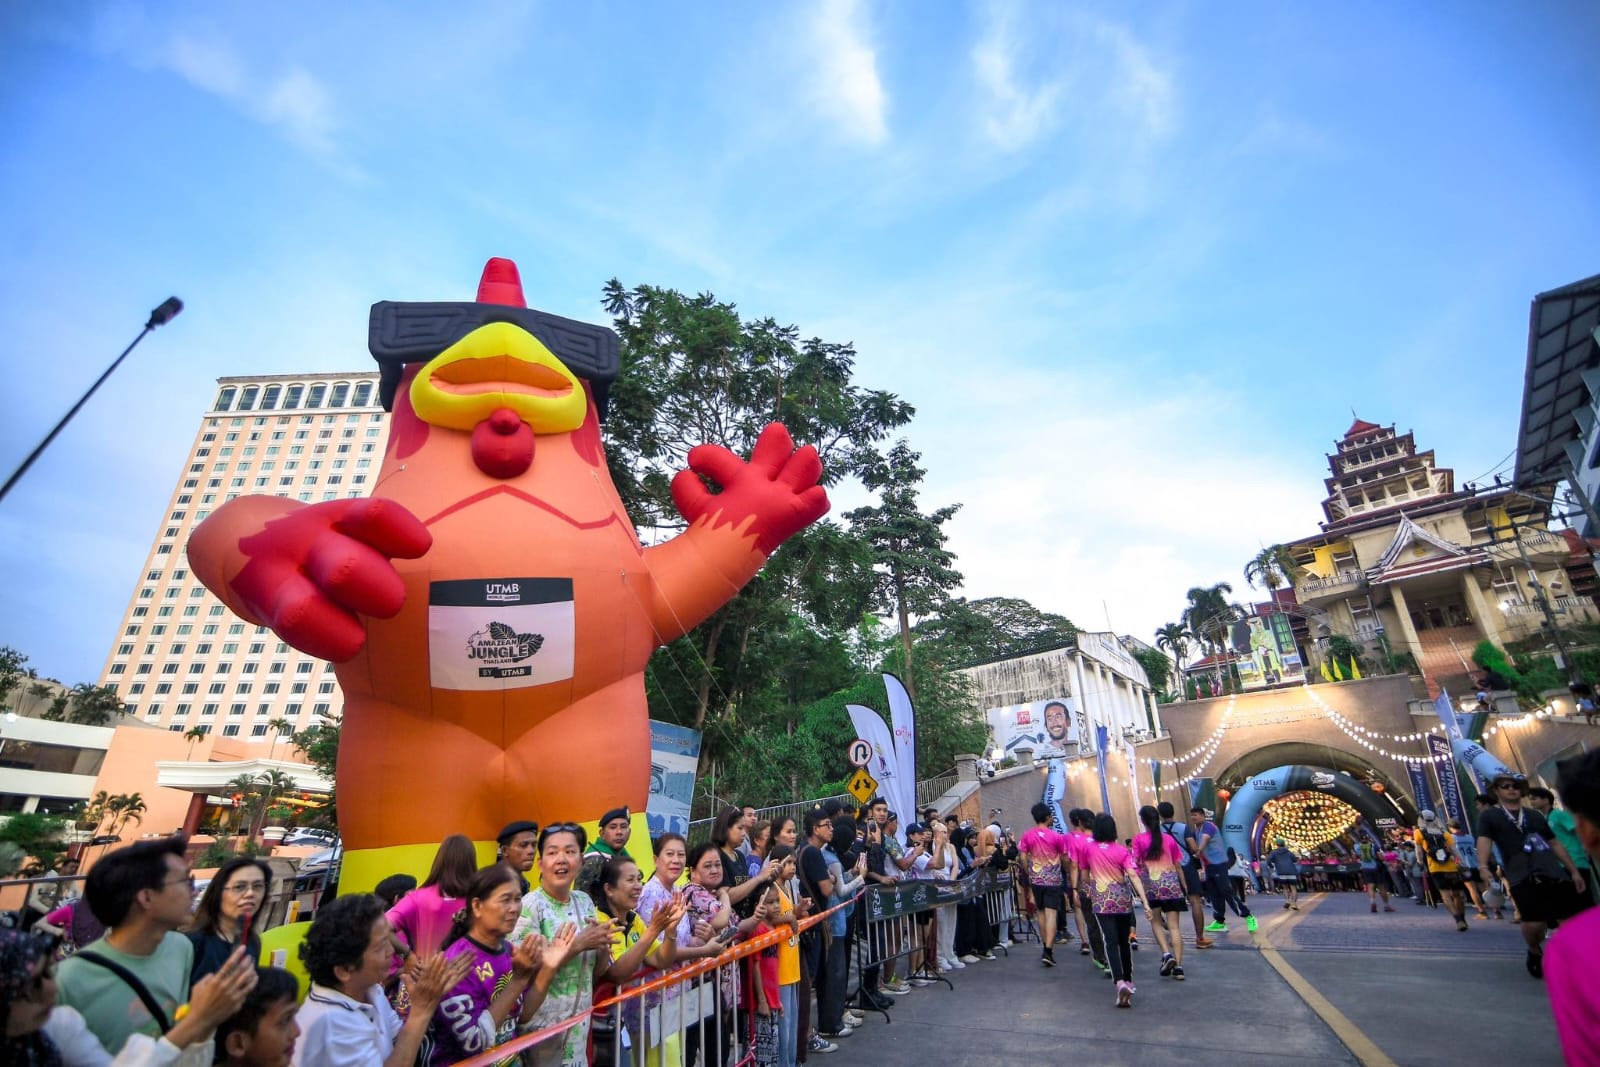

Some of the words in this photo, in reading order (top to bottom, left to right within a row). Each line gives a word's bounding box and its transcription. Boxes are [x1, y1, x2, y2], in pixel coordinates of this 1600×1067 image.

[486, 583, 519, 594] UTMB
[478, 639, 517, 647] AMAZEAN
[468, 645, 529, 659] JUNGLE
[1375, 817, 1397, 825] HOKA
